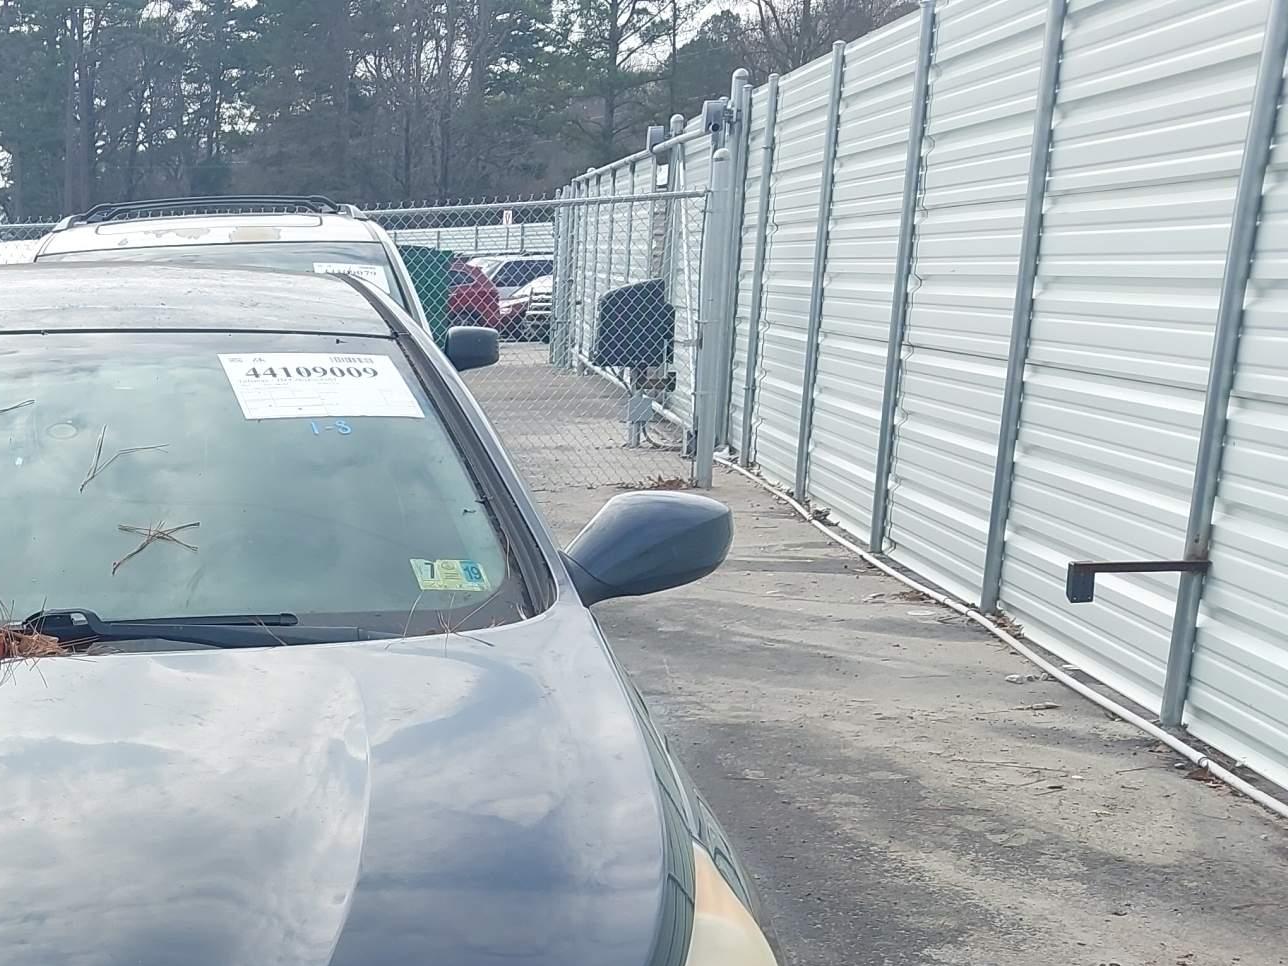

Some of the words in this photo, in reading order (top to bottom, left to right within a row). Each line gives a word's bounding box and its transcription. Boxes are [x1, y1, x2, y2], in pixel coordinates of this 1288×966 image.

[245, 366, 379, 379] 44109009
[424, 562, 435, 579] 7
[464, 566, 482, 580] 19
